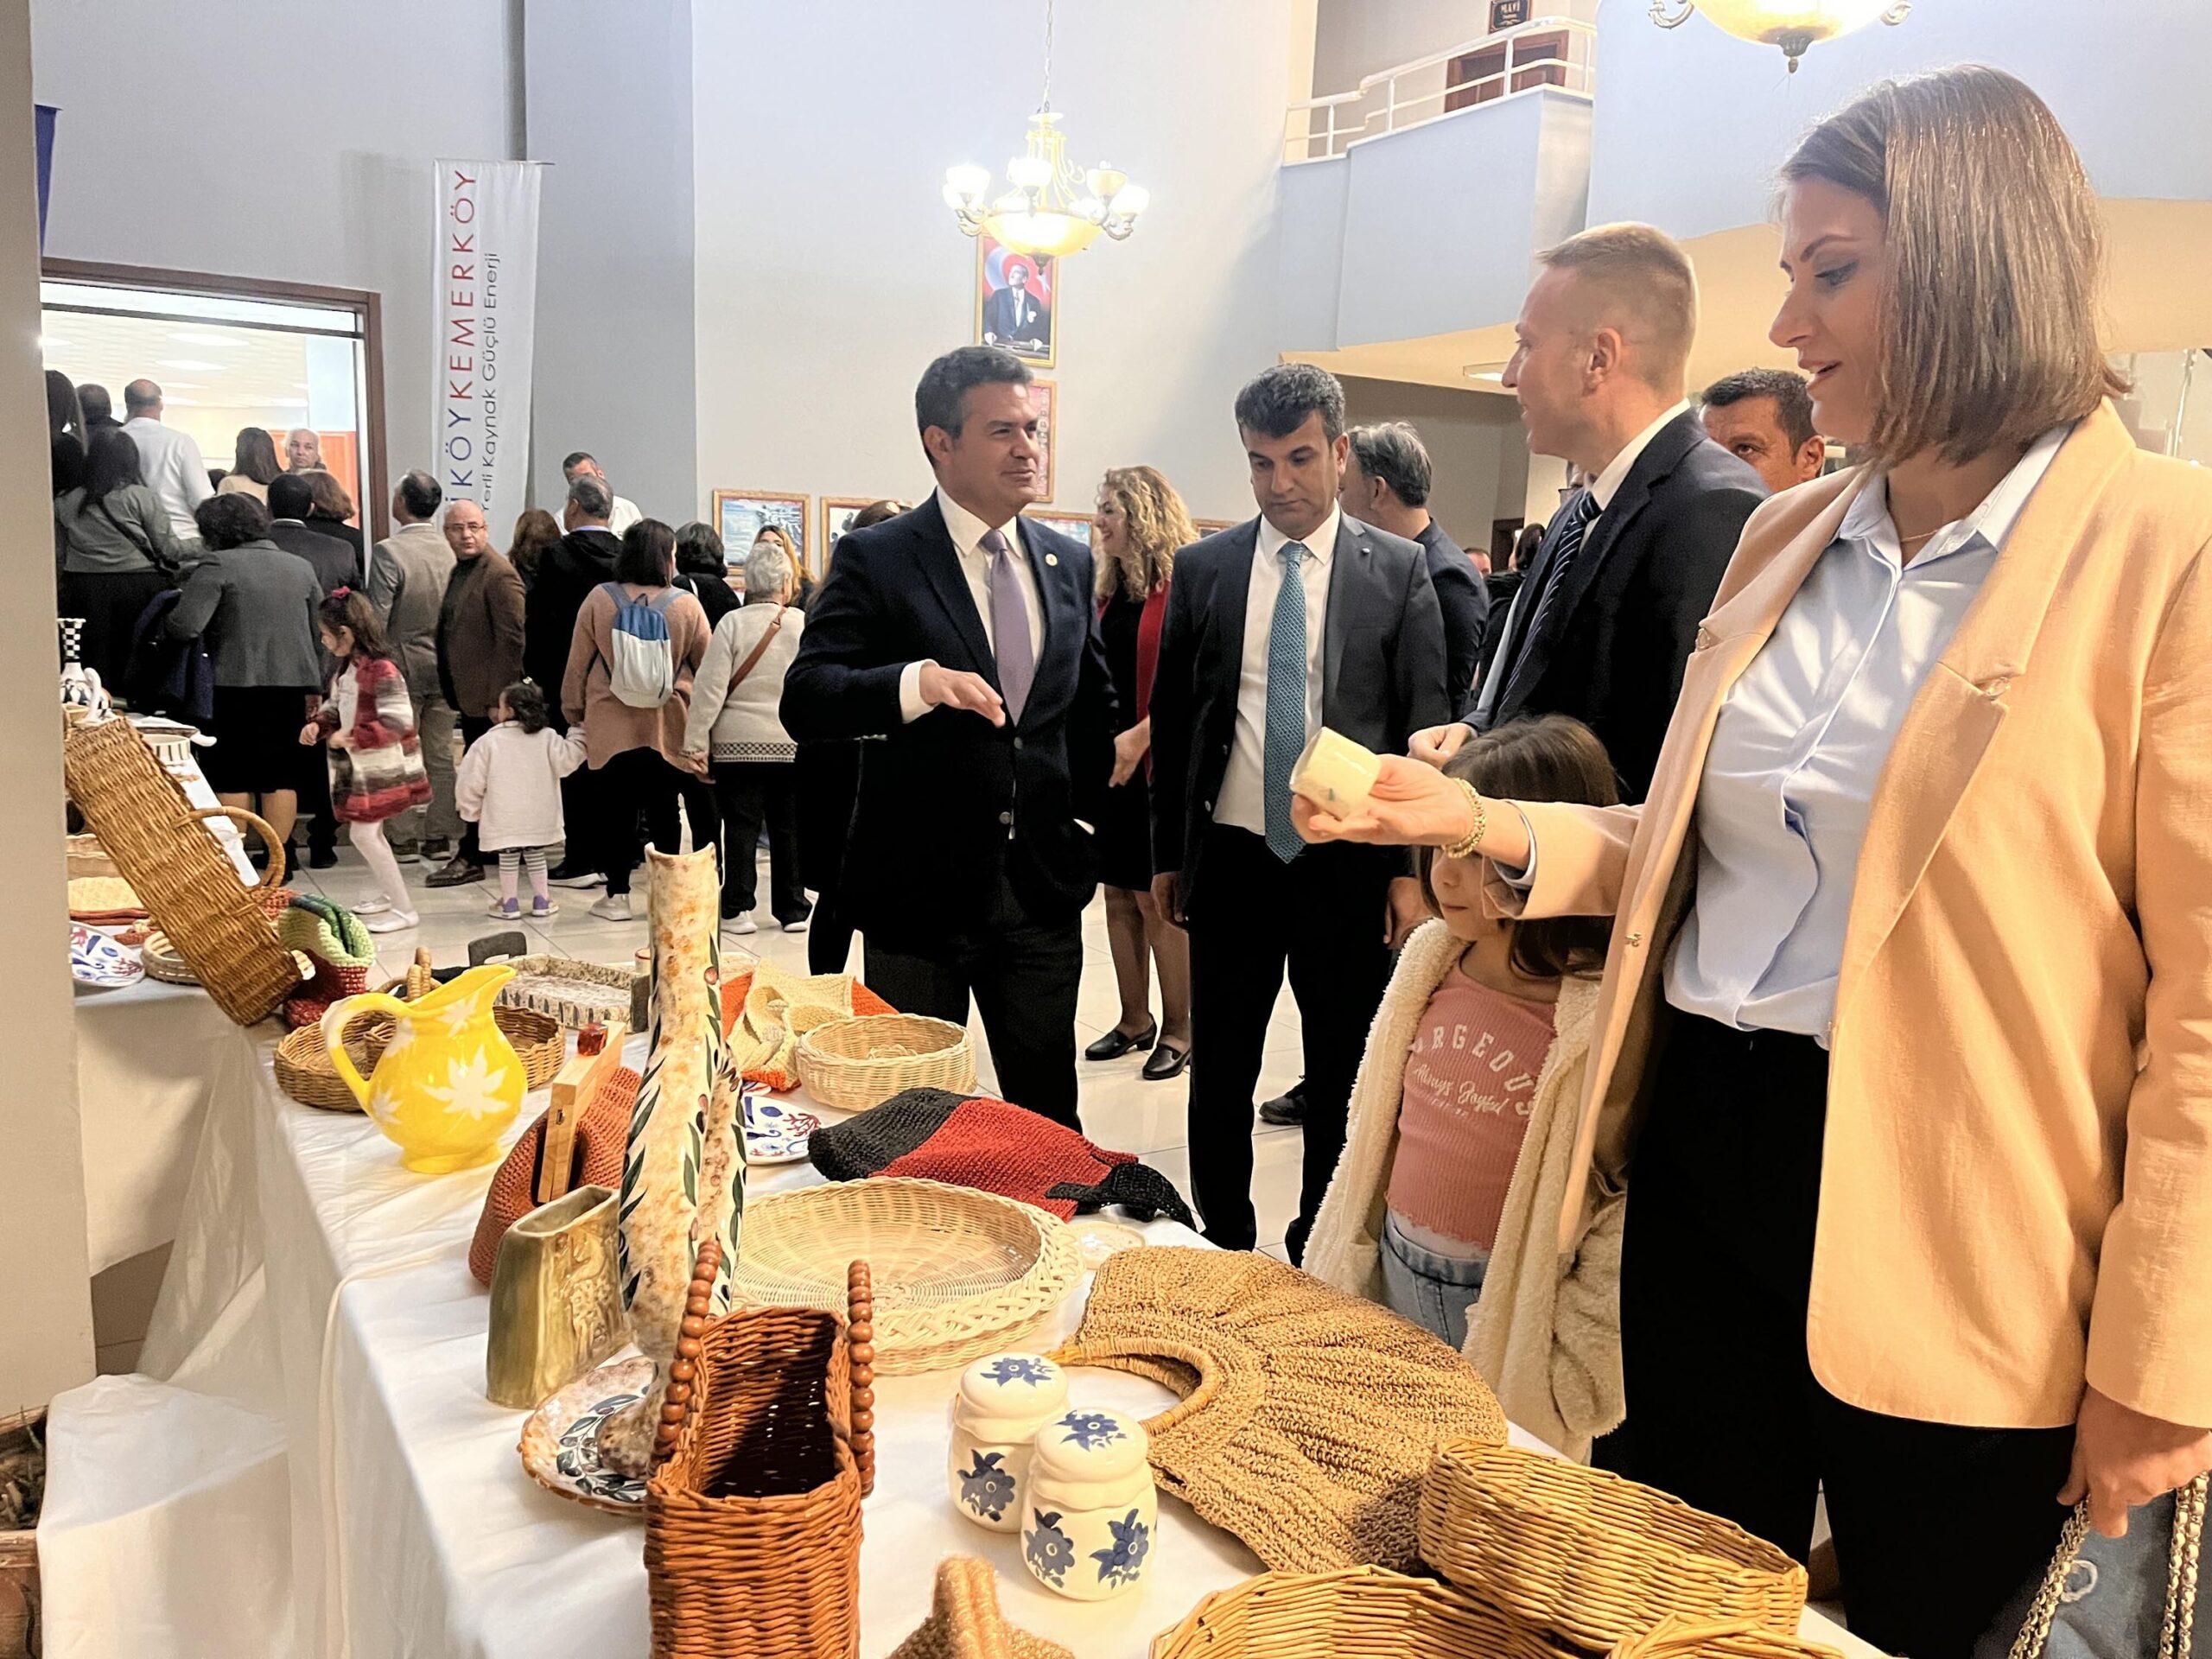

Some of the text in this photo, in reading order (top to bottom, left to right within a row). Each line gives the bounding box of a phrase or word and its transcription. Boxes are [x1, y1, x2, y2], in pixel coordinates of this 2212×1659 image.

[483, 253, 501, 308] Enerji
[482, 316, 499, 381] Güçlü
[481, 389, 499, 467] Kaynak
